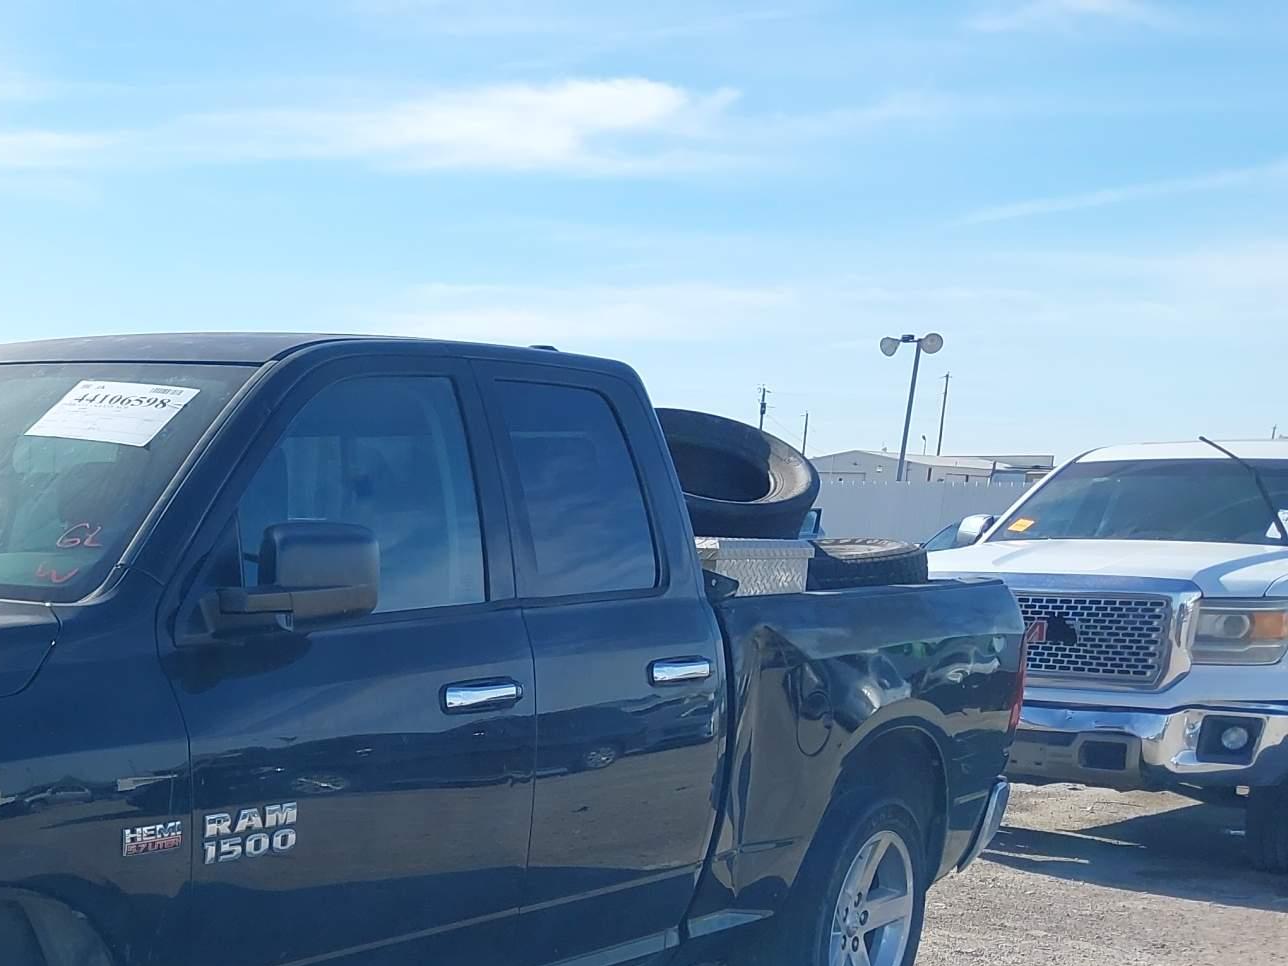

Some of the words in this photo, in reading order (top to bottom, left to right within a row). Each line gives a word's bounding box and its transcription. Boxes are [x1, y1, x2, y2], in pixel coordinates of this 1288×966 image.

[74, 392, 172, 409] 44106598
[124, 821, 182, 844] HEMI
[205, 802, 298, 838] RAM
[203, 828, 298, 864] 1500
